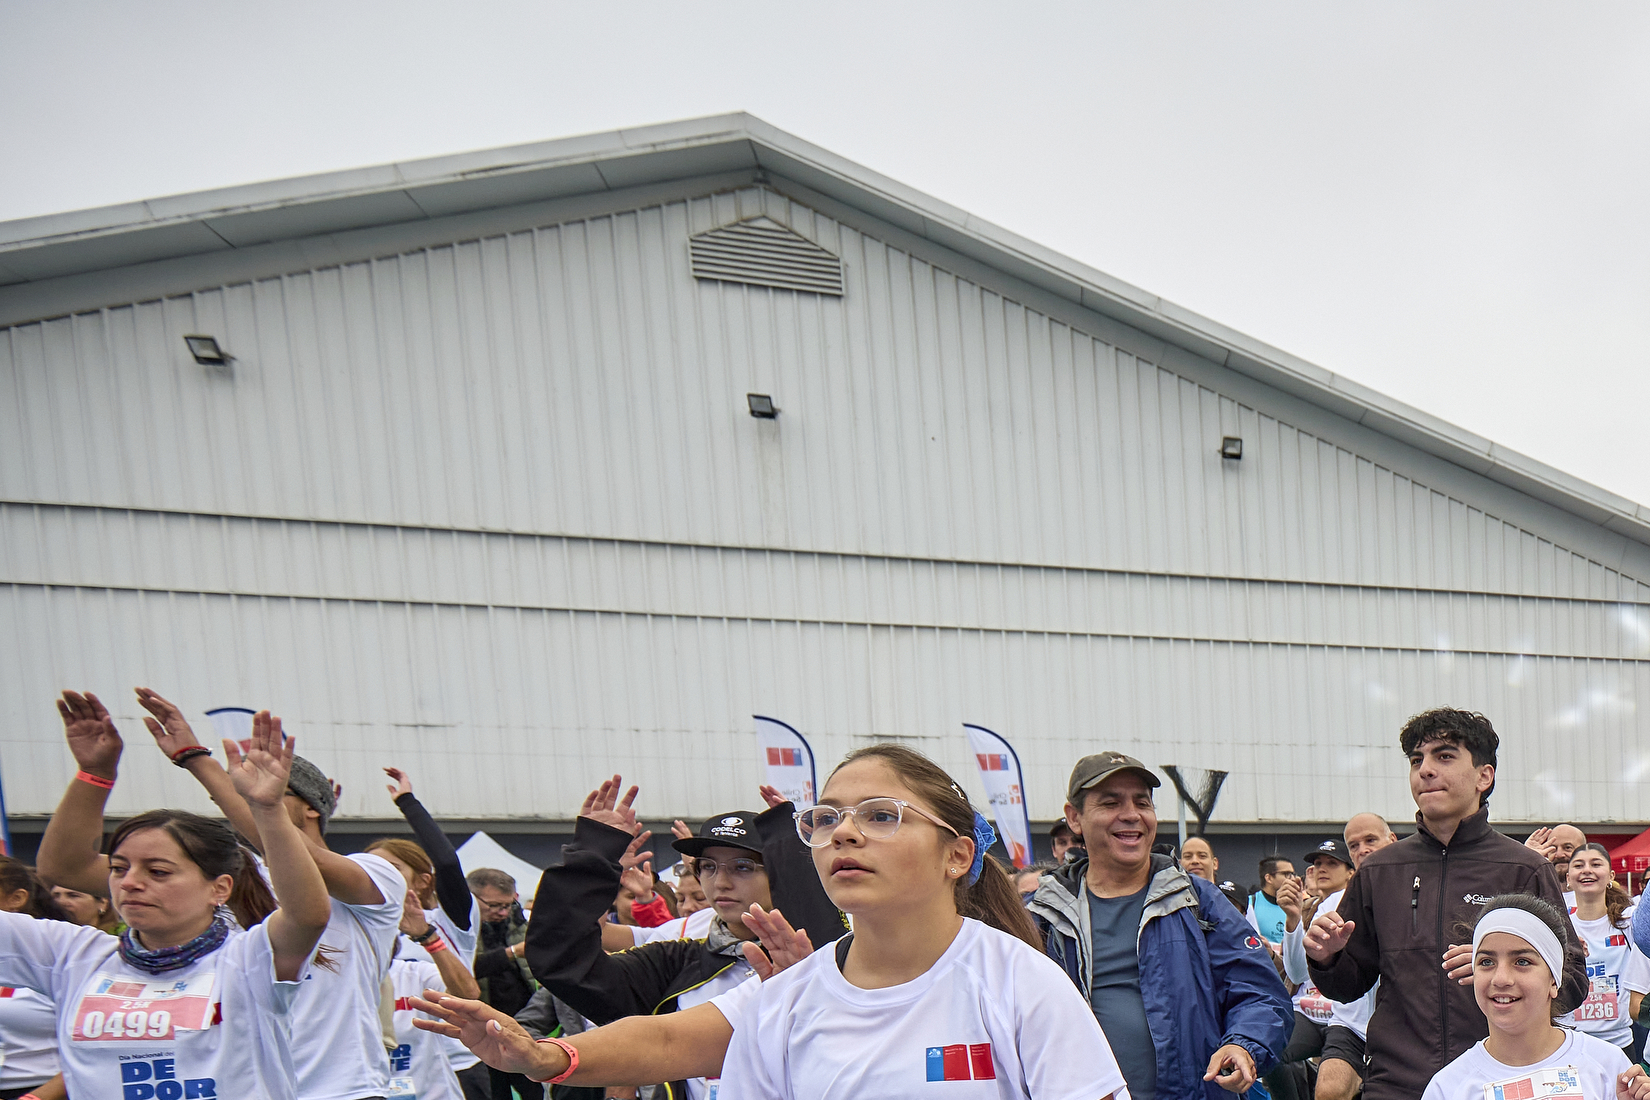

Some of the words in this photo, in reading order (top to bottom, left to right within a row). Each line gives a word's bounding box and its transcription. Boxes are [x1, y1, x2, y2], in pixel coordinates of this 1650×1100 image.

[711, 826, 747, 835] CODELCO
[1579, 1002, 1614, 1019] 1236
[82, 1010, 171, 1039] 0499
[131, 1051, 164, 1060] Nacional
[120, 1058, 176, 1084] DE
